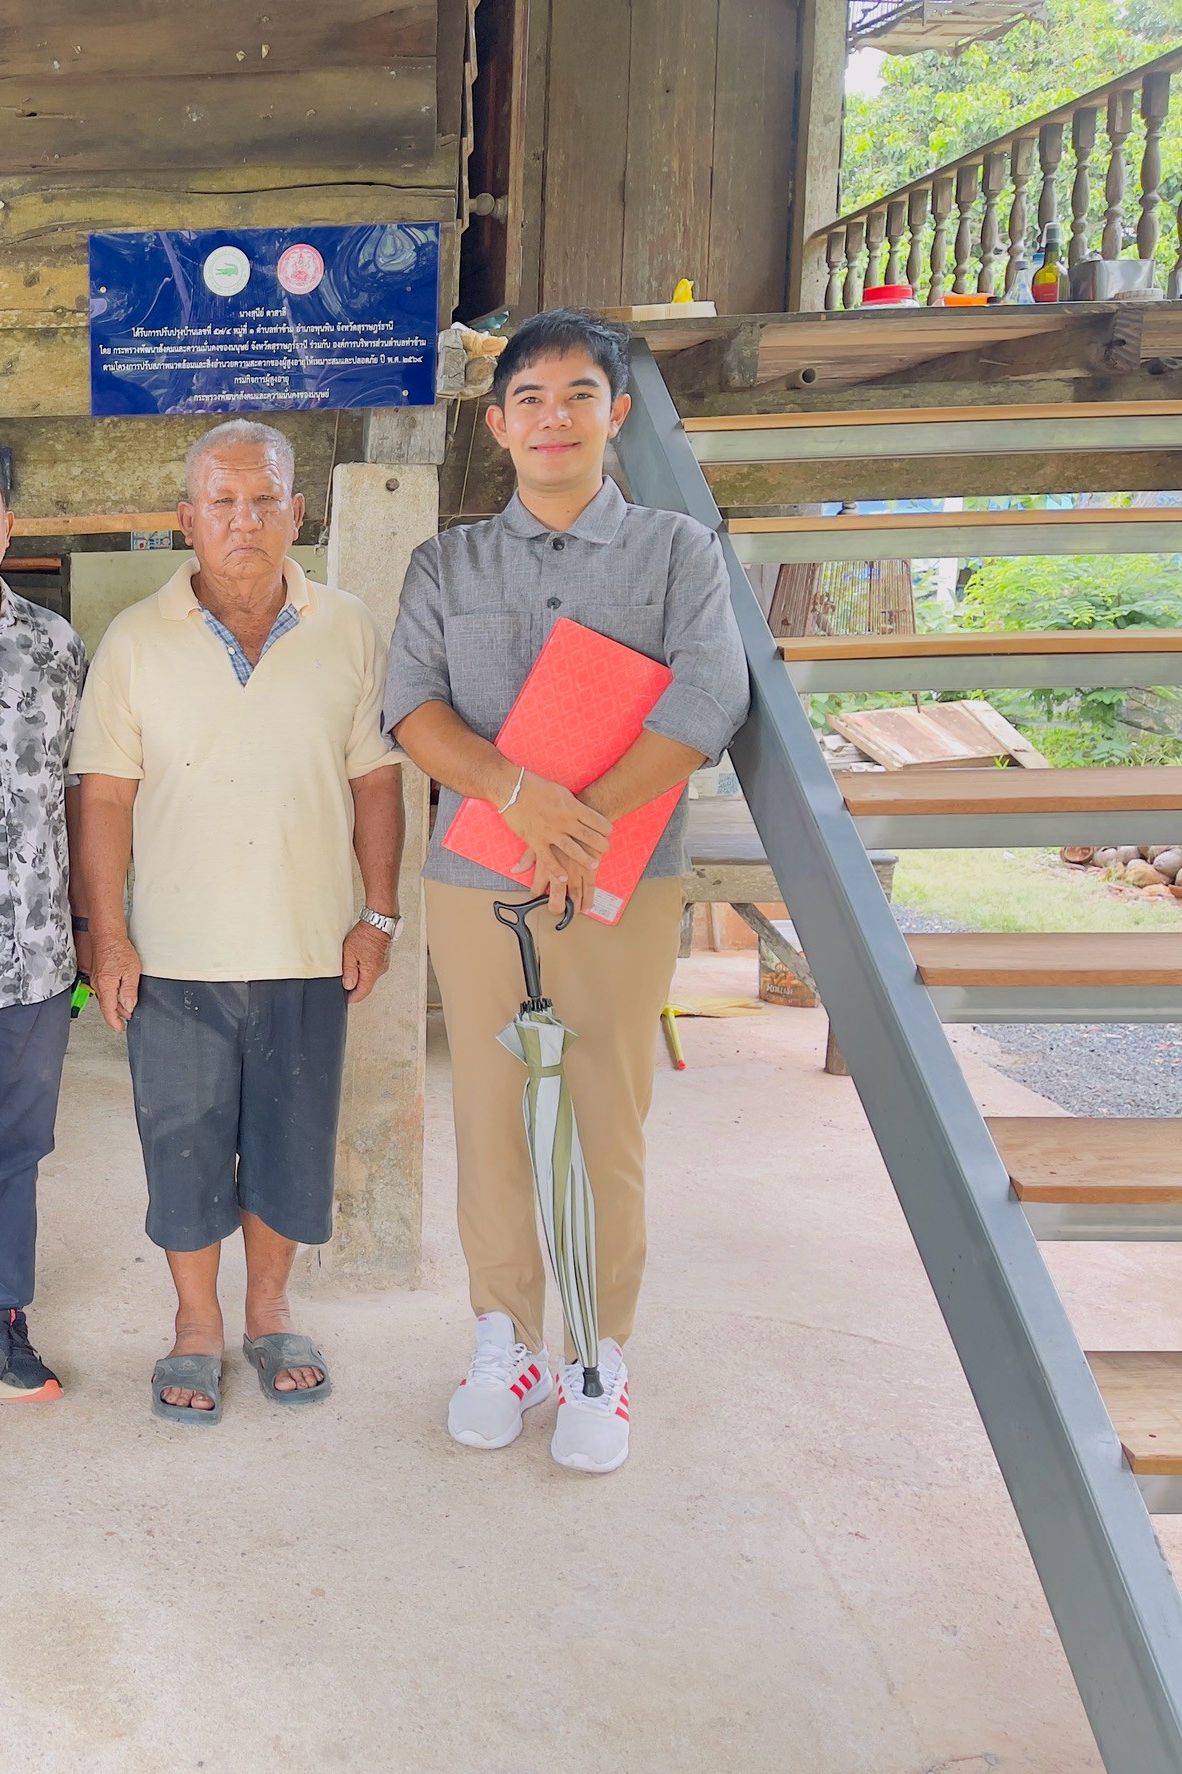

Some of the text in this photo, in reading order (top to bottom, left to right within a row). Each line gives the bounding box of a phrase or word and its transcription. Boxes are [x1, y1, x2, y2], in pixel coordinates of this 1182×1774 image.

[132, 323, 212, 339] ได้รับการปรับปรุงบ้านเลขที่
[233, 322, 248, 337] หมู่ที่
[256, 322, 294, 335] ตำบลท่าข้าม
[296, 321, 335, 336] อำเภอพุนพิน
[336, 320, 394, 335] จังหวัดสุราษฎร์ธานี
[99, 337, 427, 356] โดย กระทรวงพัฒนาสังคมและความมั่นคงของมนุษย์ จังหวัดสุราษฎร์ธานี ร่วมกับ องค์การบริหารส่วนตำบลท่าข้าม
[380, 354, 386, 364] ปี
[387, 356, 402, 365] พ.ศ.
[234, 374, 290, 386] กรมกิจการผู้สูงอายุ
